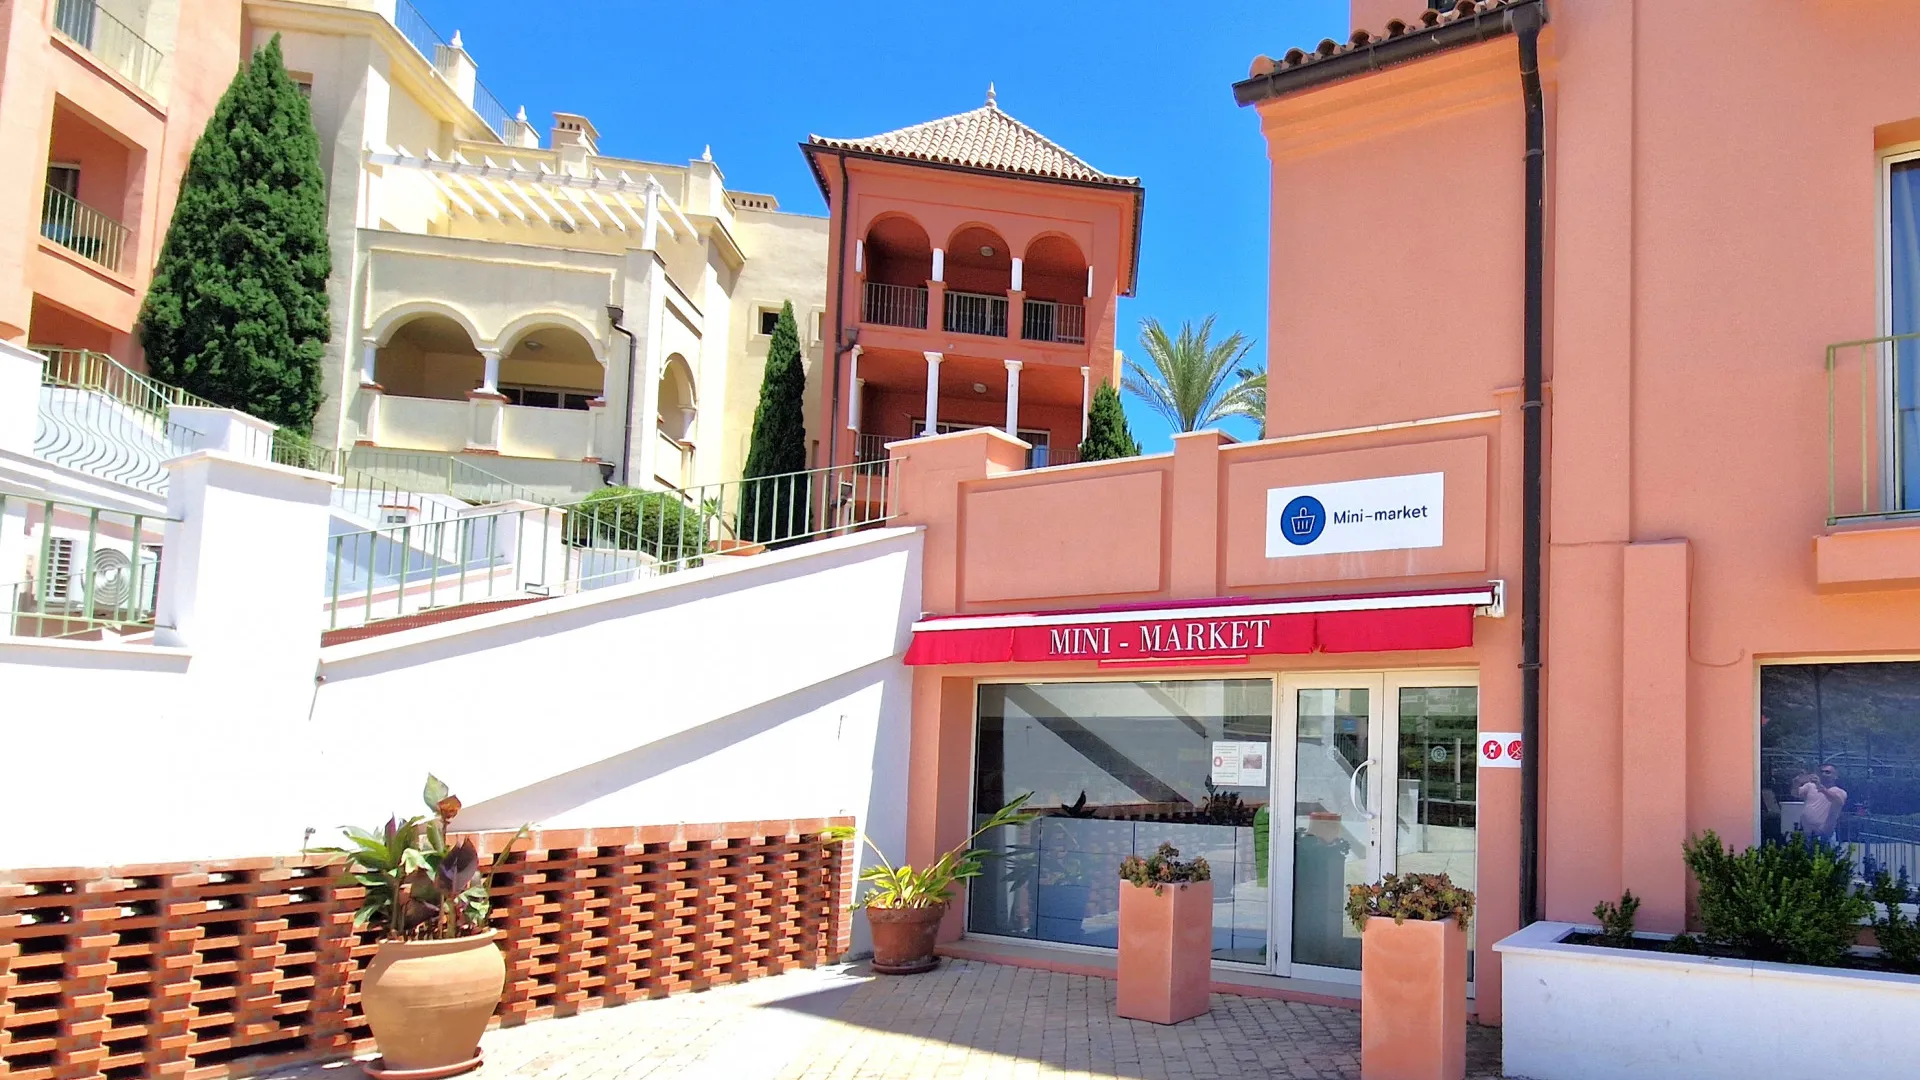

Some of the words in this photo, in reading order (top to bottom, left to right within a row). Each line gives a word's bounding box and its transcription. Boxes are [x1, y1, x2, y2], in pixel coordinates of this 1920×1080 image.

[1333, 505, 1428, 525] Mini-market
[1049, 627, 1112, 655] MINI
[1139, 619, 1271, 652] MARKET
